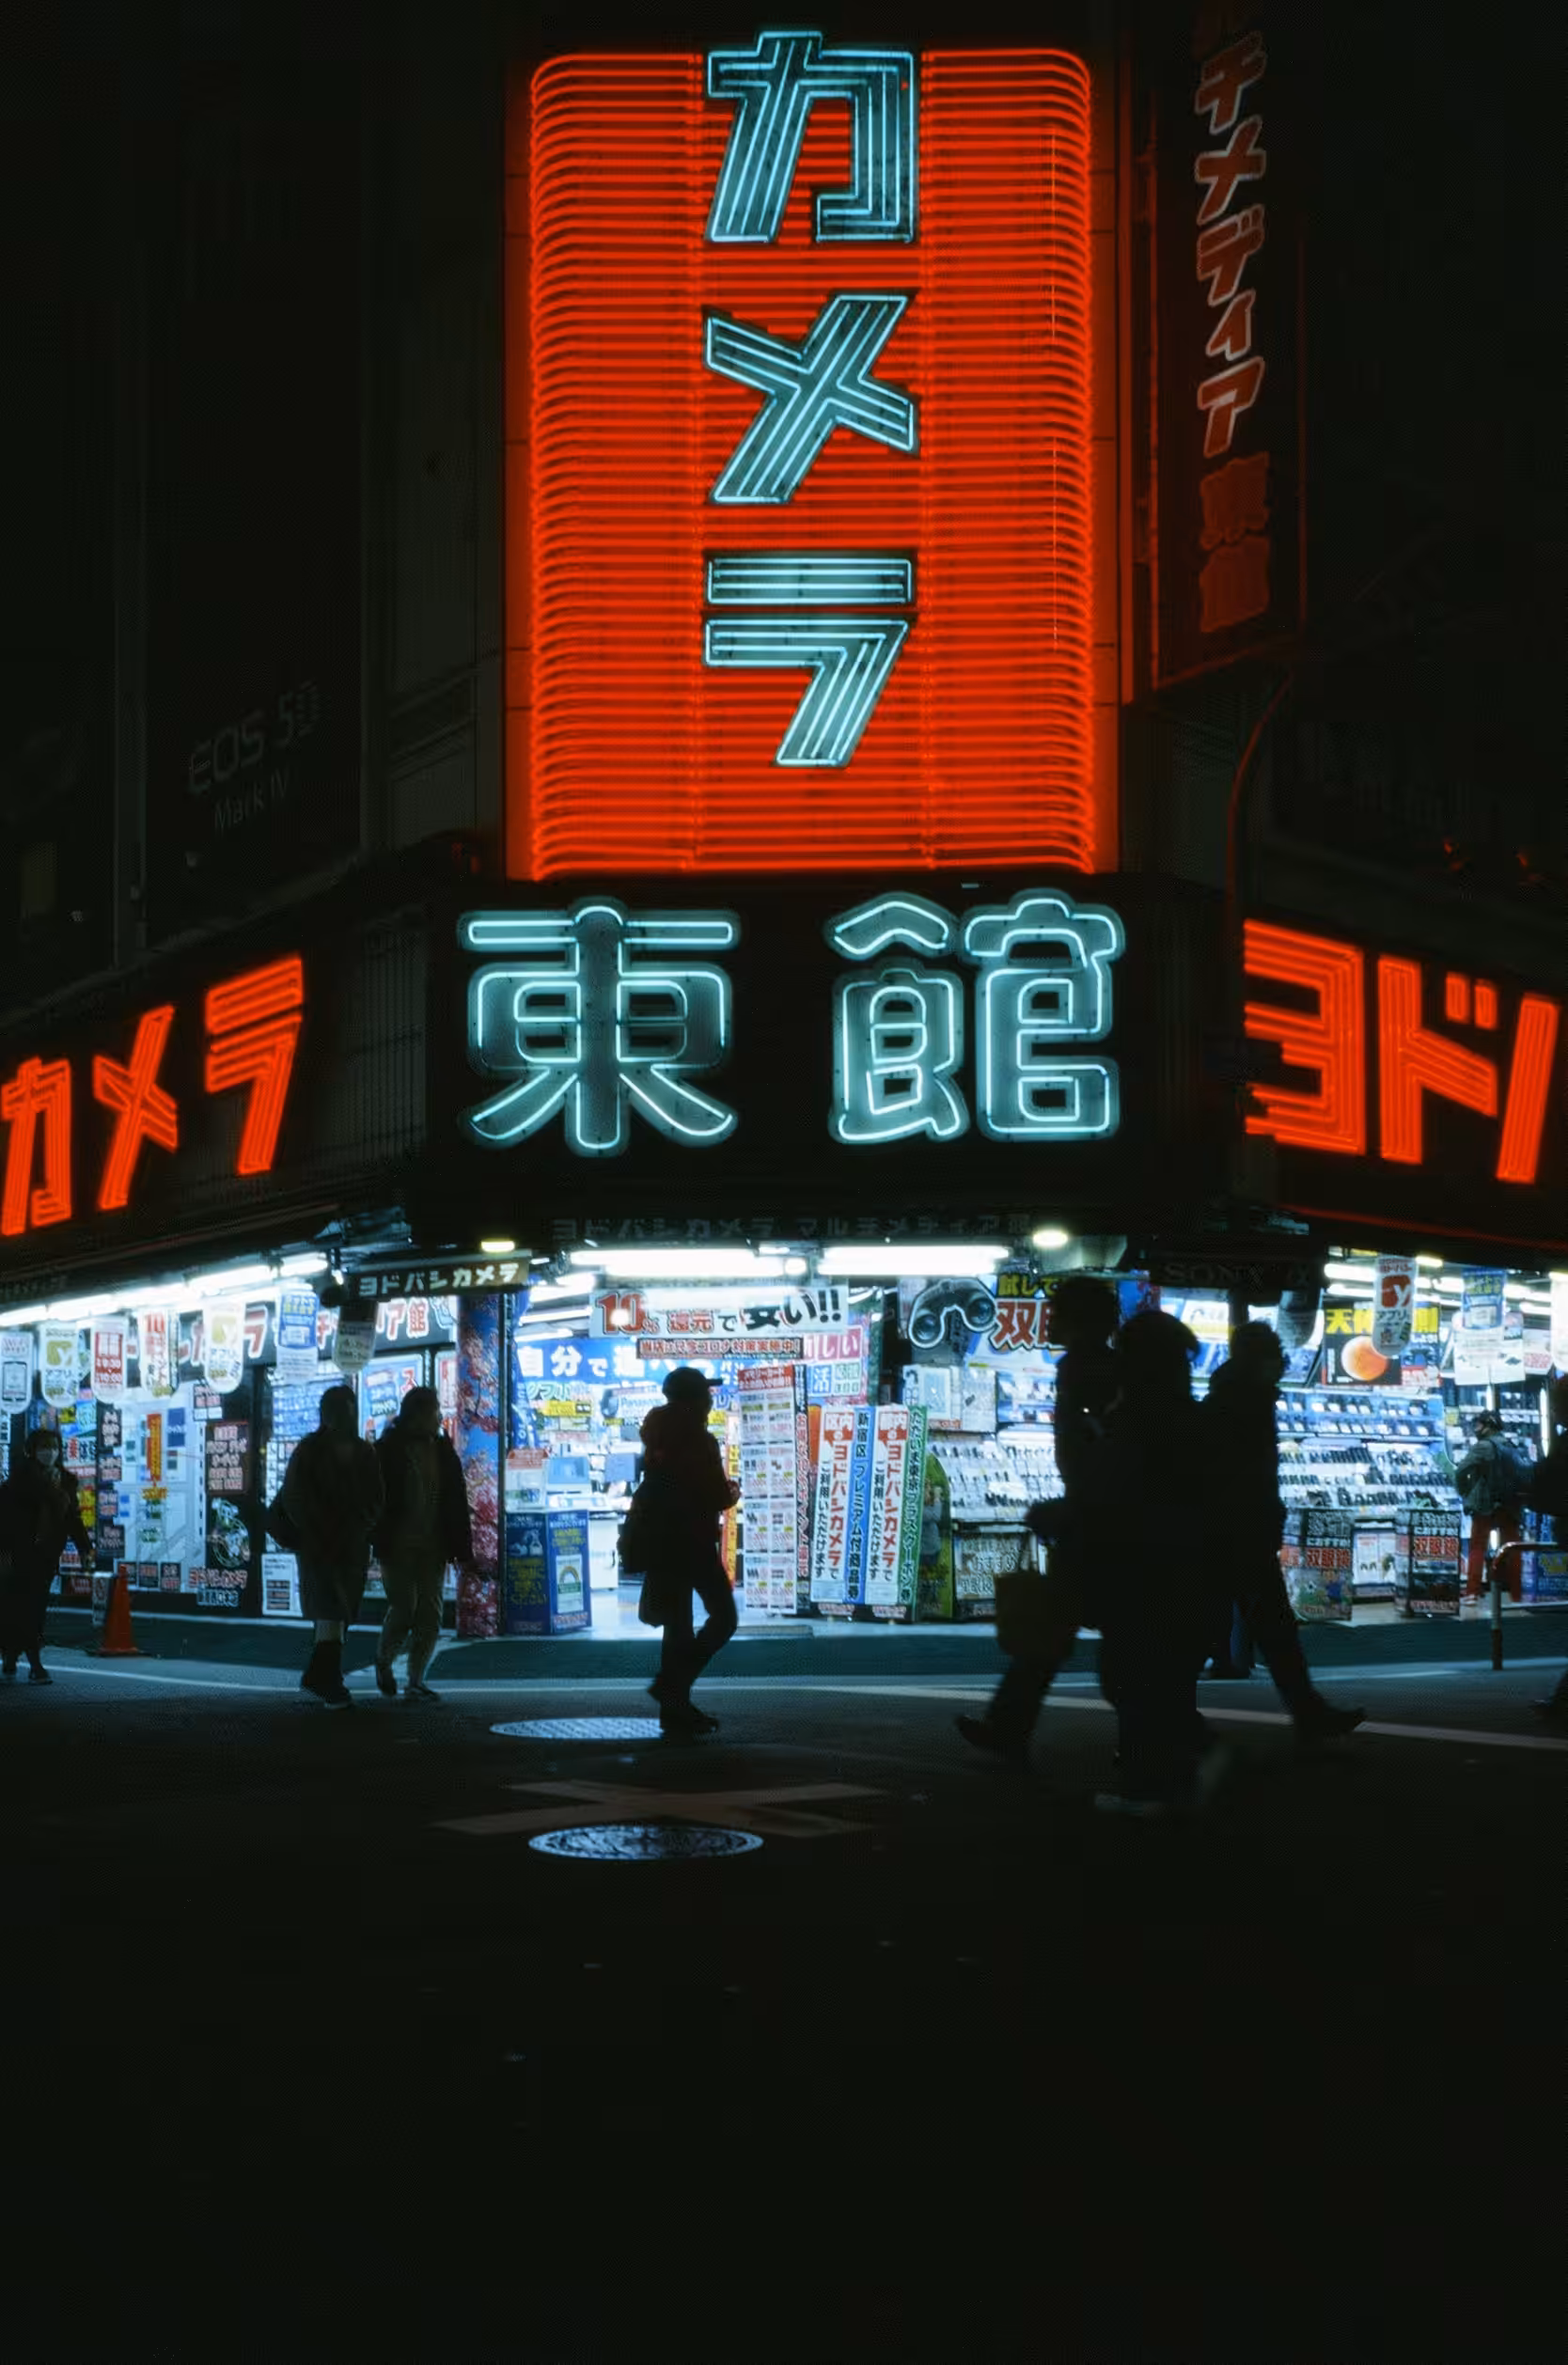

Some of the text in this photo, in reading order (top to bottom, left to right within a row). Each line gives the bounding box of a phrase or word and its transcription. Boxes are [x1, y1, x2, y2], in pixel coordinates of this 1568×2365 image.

[705, 30, 917, 768] カメラ
[186, 709, 266, 794] EOS
[213, 778, 264, 838] Mark
[0, 954, 303, 1235] カメラ
[461, 891, 1123, 1154] 東館
[359, 1263, 518, 1296] ヨドバシカメラ
